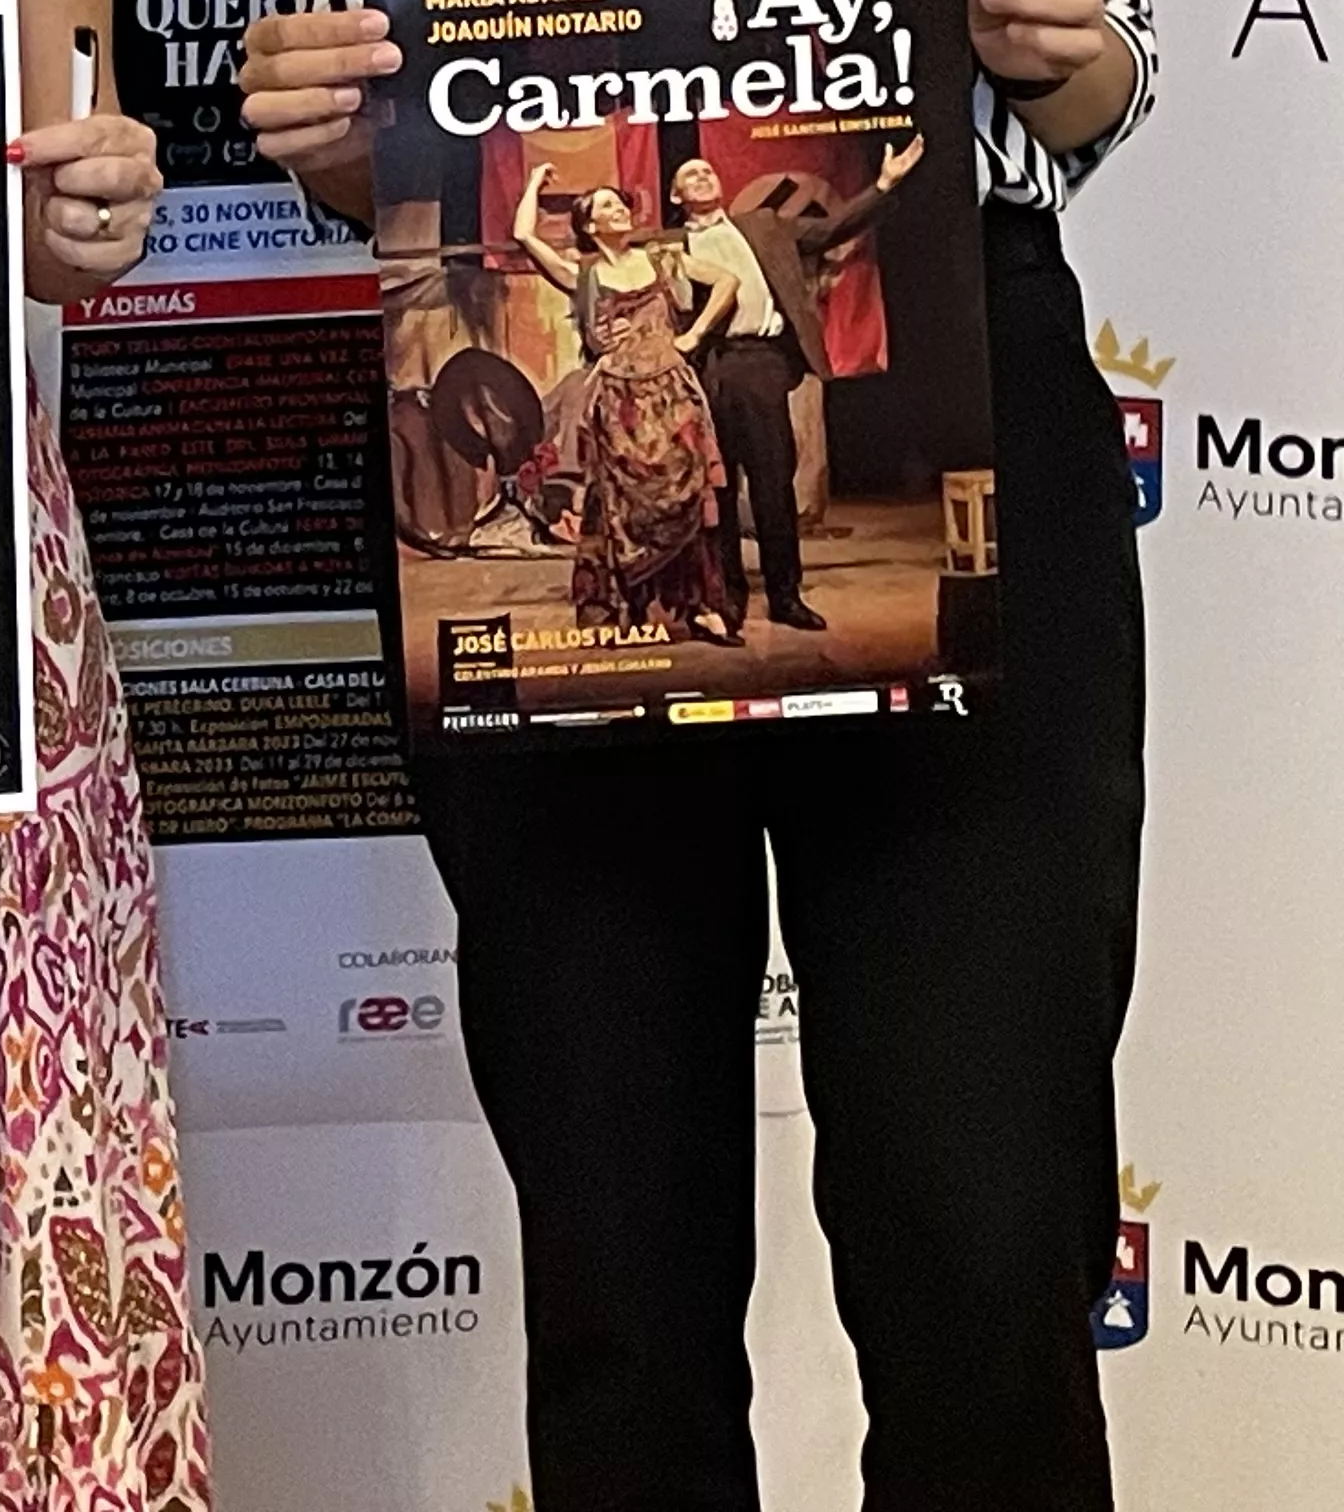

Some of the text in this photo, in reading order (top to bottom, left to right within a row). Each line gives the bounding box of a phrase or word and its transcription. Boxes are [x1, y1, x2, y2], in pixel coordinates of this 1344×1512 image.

[427, 9, 641, 44] JOAQUÍN NOTARIO
[428, 29, 916, 138] Carmela!
[181, 204, 209, 223] 30
[185, 233, 240, 253] CINE
[80, 291, 195, 317] Y ADEMÁS
[454, 624, 671, 656] JOSÉ CARLOS PLAZA
[204, 1243, 480, 1309] Monzón
[205, 1307, 479, 1354] Ayuntamiento
